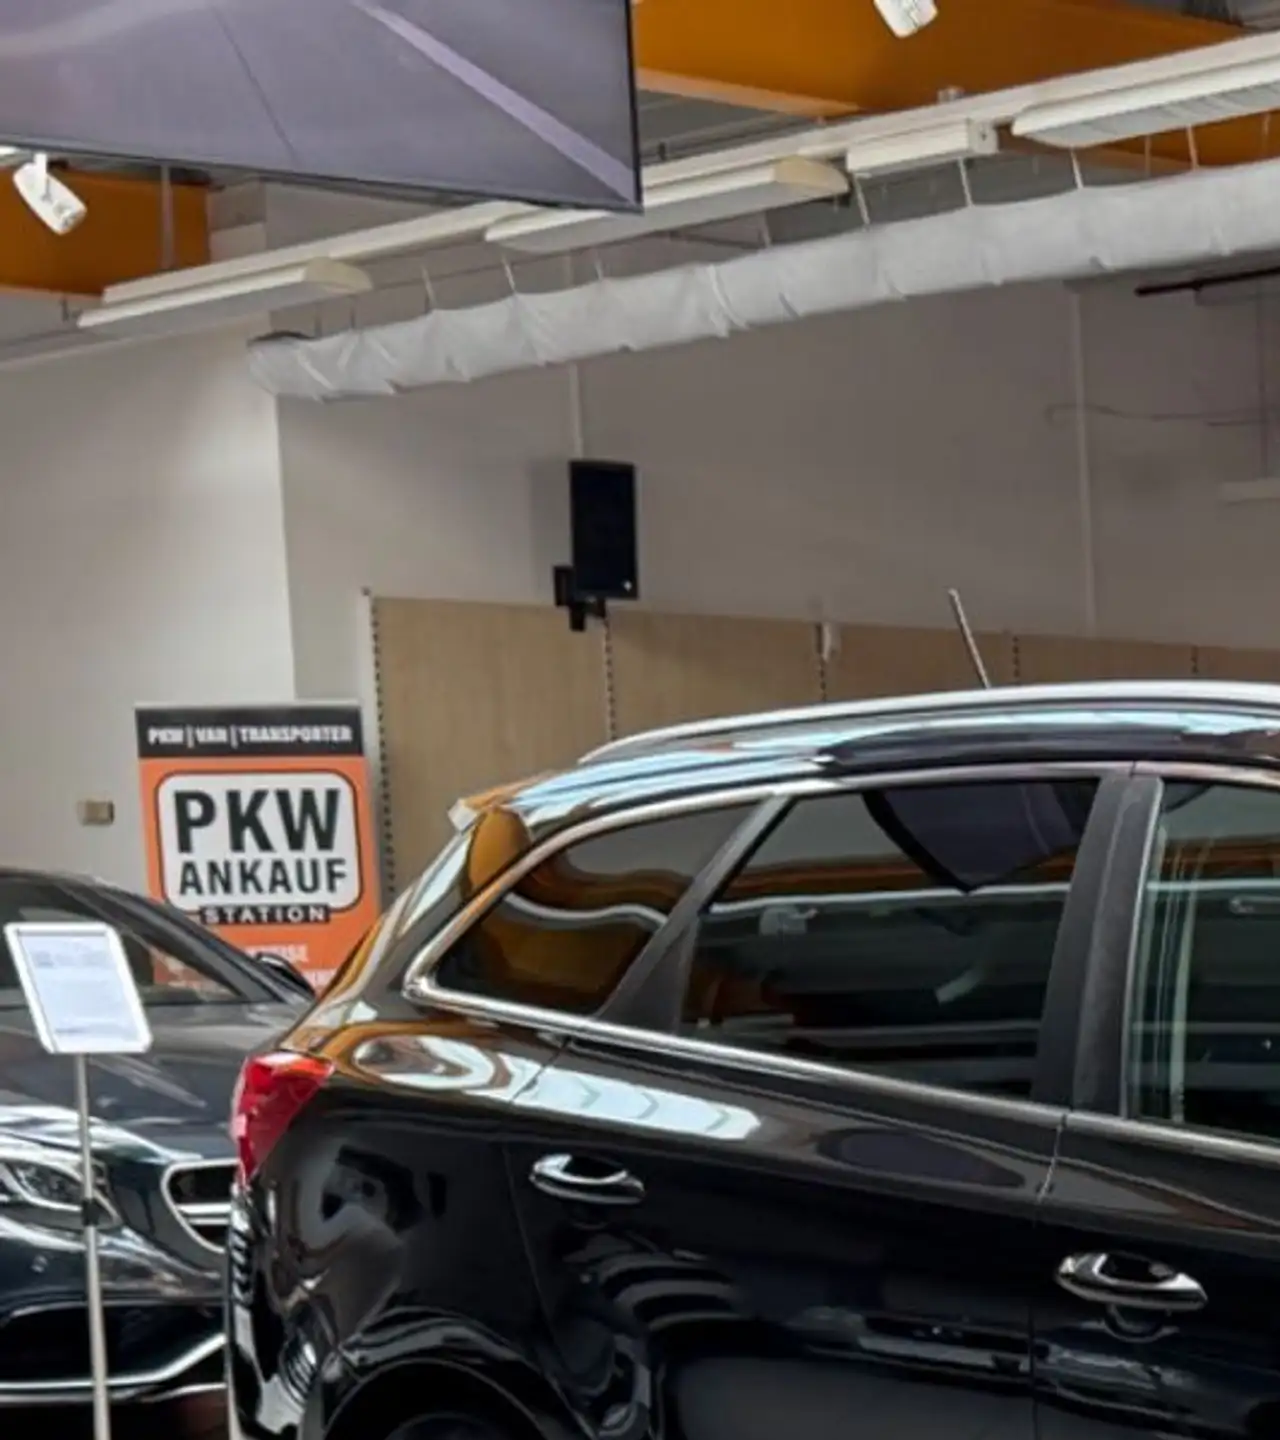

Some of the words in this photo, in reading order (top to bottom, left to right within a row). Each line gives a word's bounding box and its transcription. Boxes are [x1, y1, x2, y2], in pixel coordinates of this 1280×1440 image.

[240, 725, 352, 743] TRANSPORTER
[174, 788, 341, 853] PKW
[179, 858, 346, 895] ANKAUF
[204, 905, 325, 924] STATION
